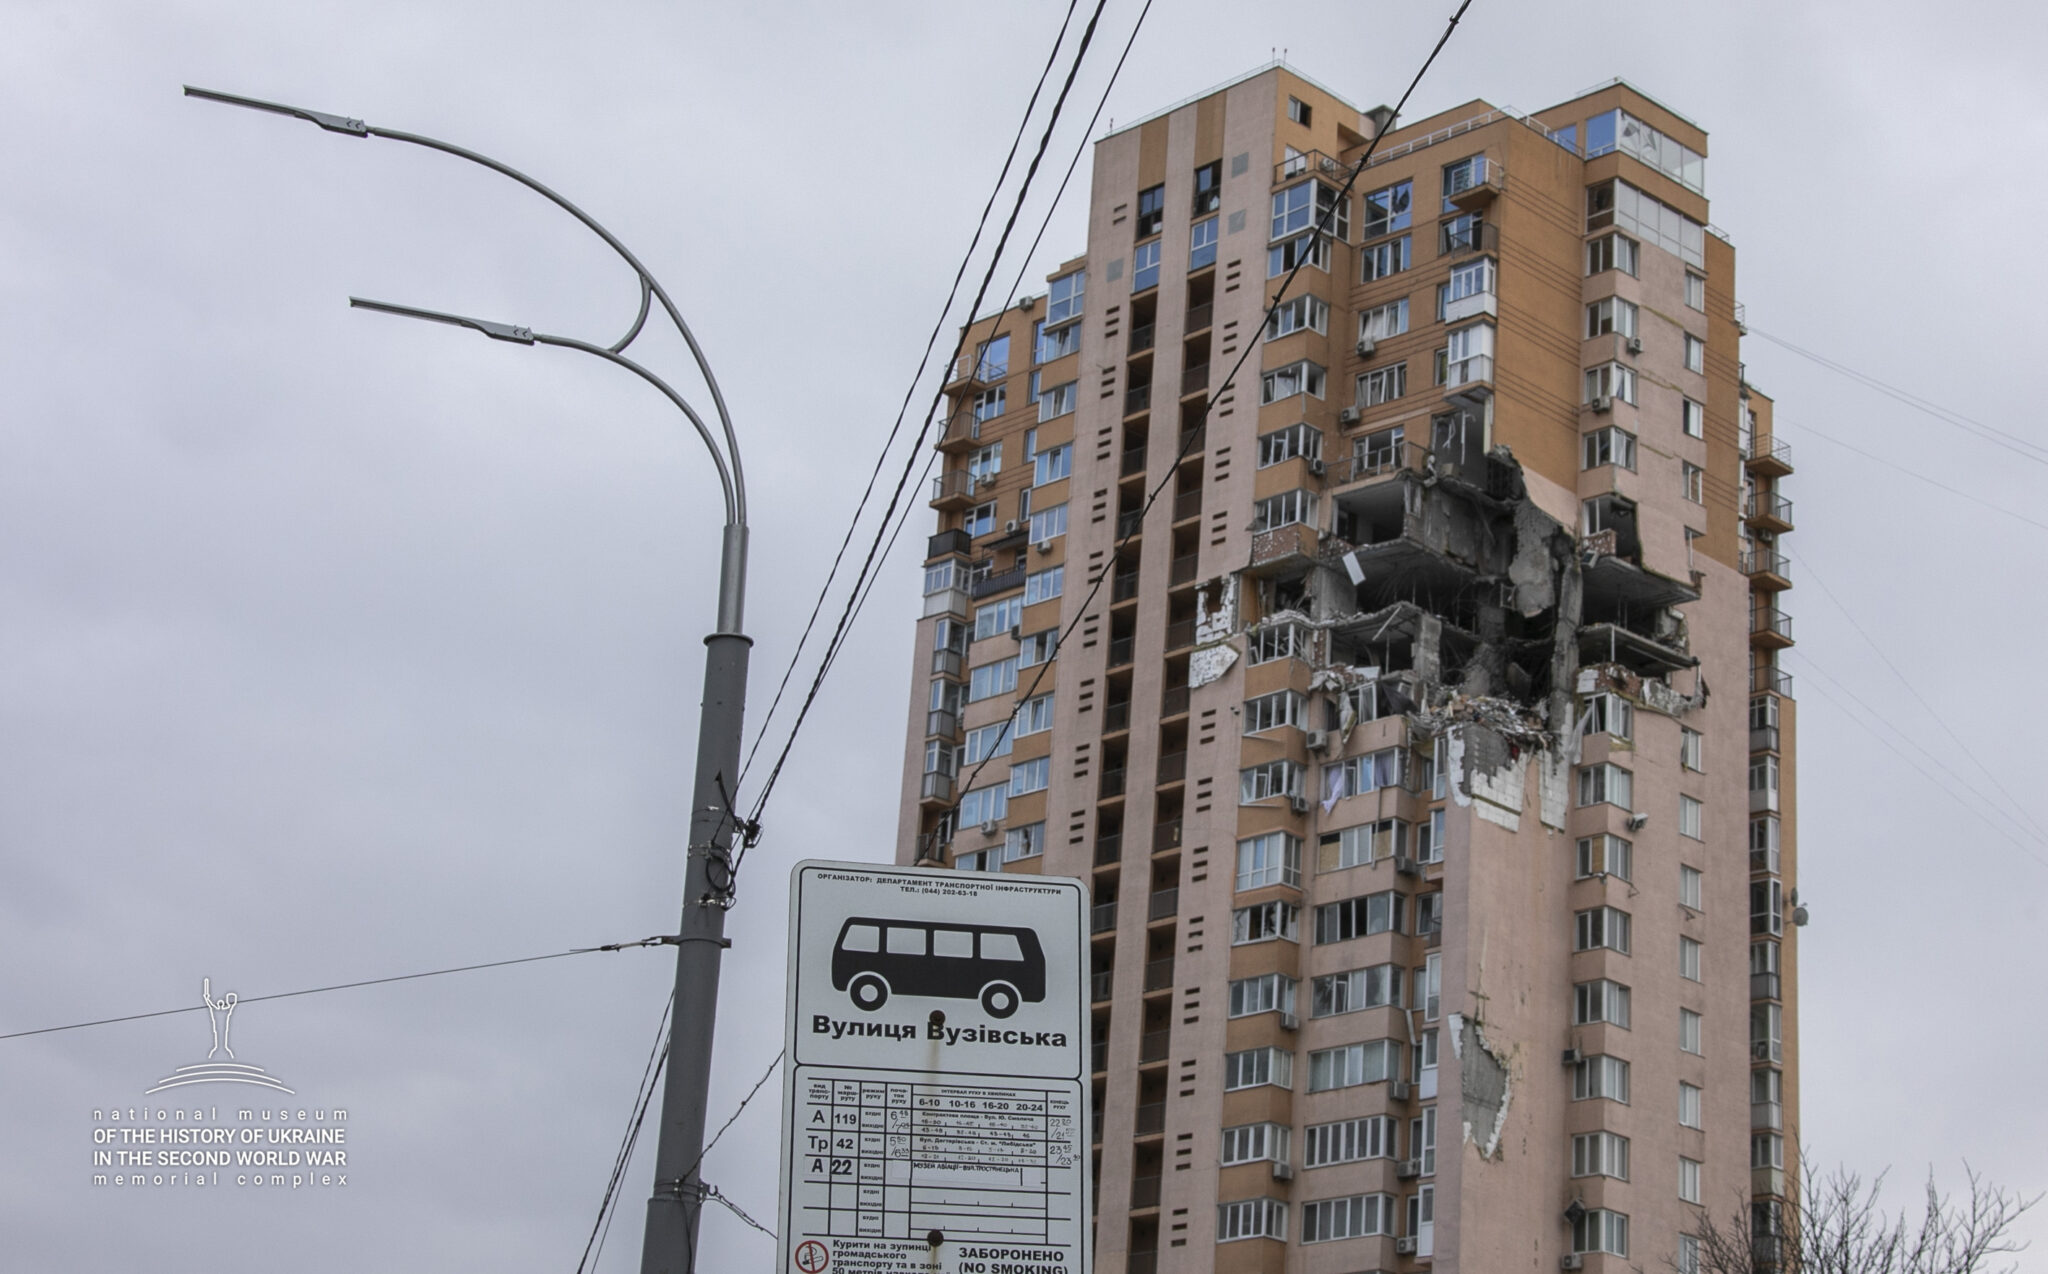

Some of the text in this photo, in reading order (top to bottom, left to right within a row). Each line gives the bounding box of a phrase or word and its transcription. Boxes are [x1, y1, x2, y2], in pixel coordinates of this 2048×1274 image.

[817, 873, 1061, 895] ОРГАНІЗАТОР: ДЕПАРТАМЕНТ ТРАНСПОРТНОЇ ІНФРАСТРУКТУРИ
[921, 888, 940, 896] (044)
[812, 1015, 1067, 1047] Вулиця Вузівська
[919, 1098, 1043, 1112] 6-10 10-16 16-20 20-24
[834, 1113, 857, 1125] 119
[808, 1135, 829, 1153] Тр
[836, 1138, 854, 1150] 42
[831, 1159, 853, 1176] 22
[833, 1239, 871, 1250] Курити
[890, 1243, 932, 1252] зупинці
[832, 1250, 907, 1260] громадського
[958, 1247, 1064, 1262] ЗАБОРОНЕНО
[832, 1259, 893, 1269] транспорту
[896, 1261, 908, 1269] та
[920, 1262, 942, 1270] зоні
[958, 1262, 1068, 1274] (NO SMOKING)
